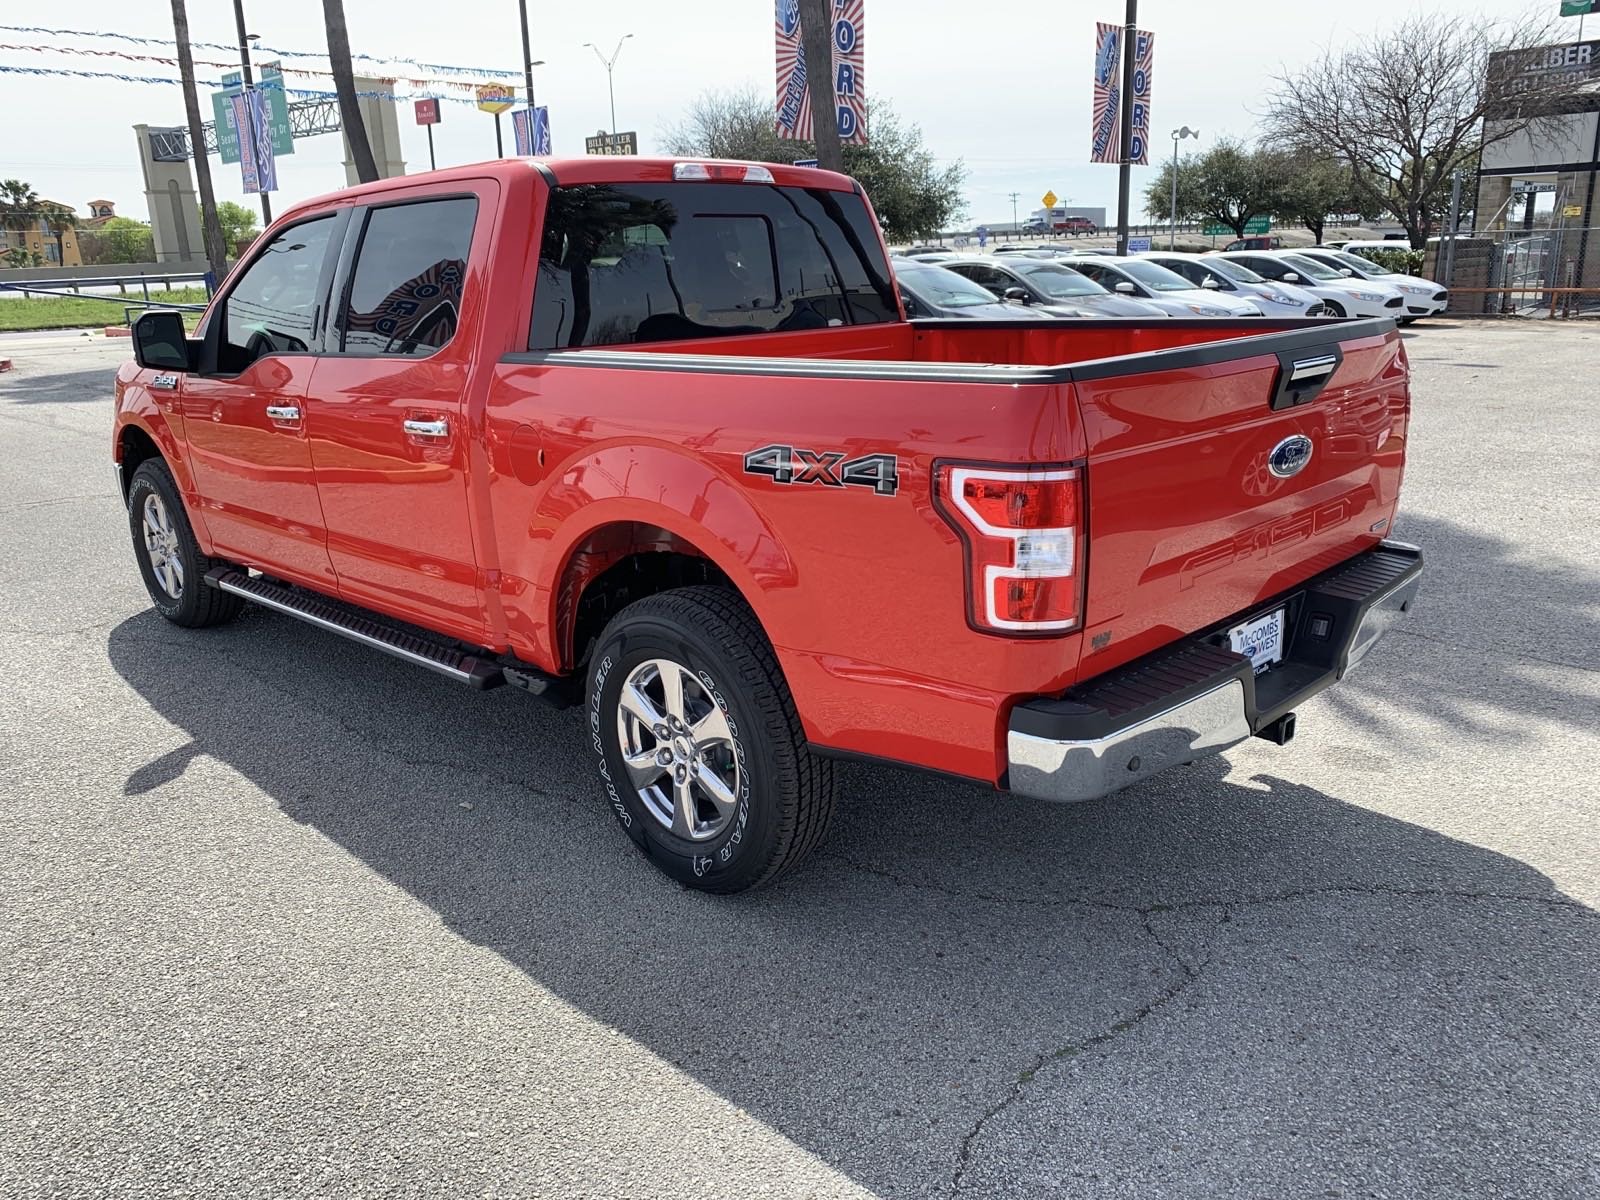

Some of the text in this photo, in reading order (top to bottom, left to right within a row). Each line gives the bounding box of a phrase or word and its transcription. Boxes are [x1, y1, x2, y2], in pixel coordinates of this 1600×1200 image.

[1130, 36, 1148, 160] FORD
[256, 106, 271, 175] Ford
[588, 138, 604, 148] BILL
[1280, 440, 1309, 470] Ford
[1240, 619, 1279, 650] McCOMBS
[1259, 632, 1280, 652] WEST
[590, 656, 633, 828] WRANGLER
[698, 670, 750, 862] GOODYEAR
